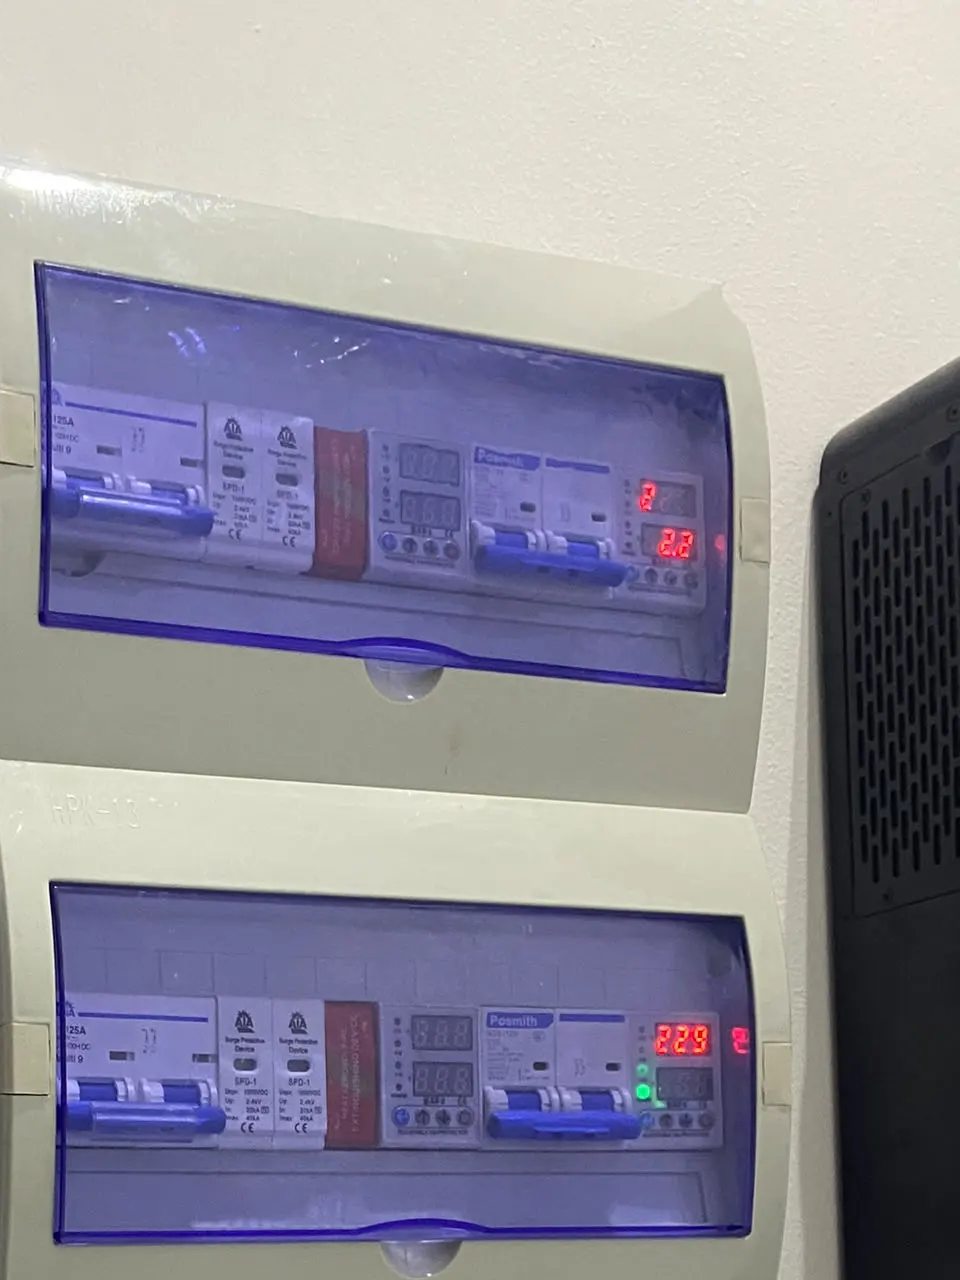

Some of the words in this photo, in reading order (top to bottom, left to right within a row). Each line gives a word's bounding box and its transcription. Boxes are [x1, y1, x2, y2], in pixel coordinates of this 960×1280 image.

[639, 482, 656, 513] 2
[658, 528, 694, 558] 2.2
[490, 1013, 538, 1027] Posmith
[655, 1024, 708, 1055] 229
